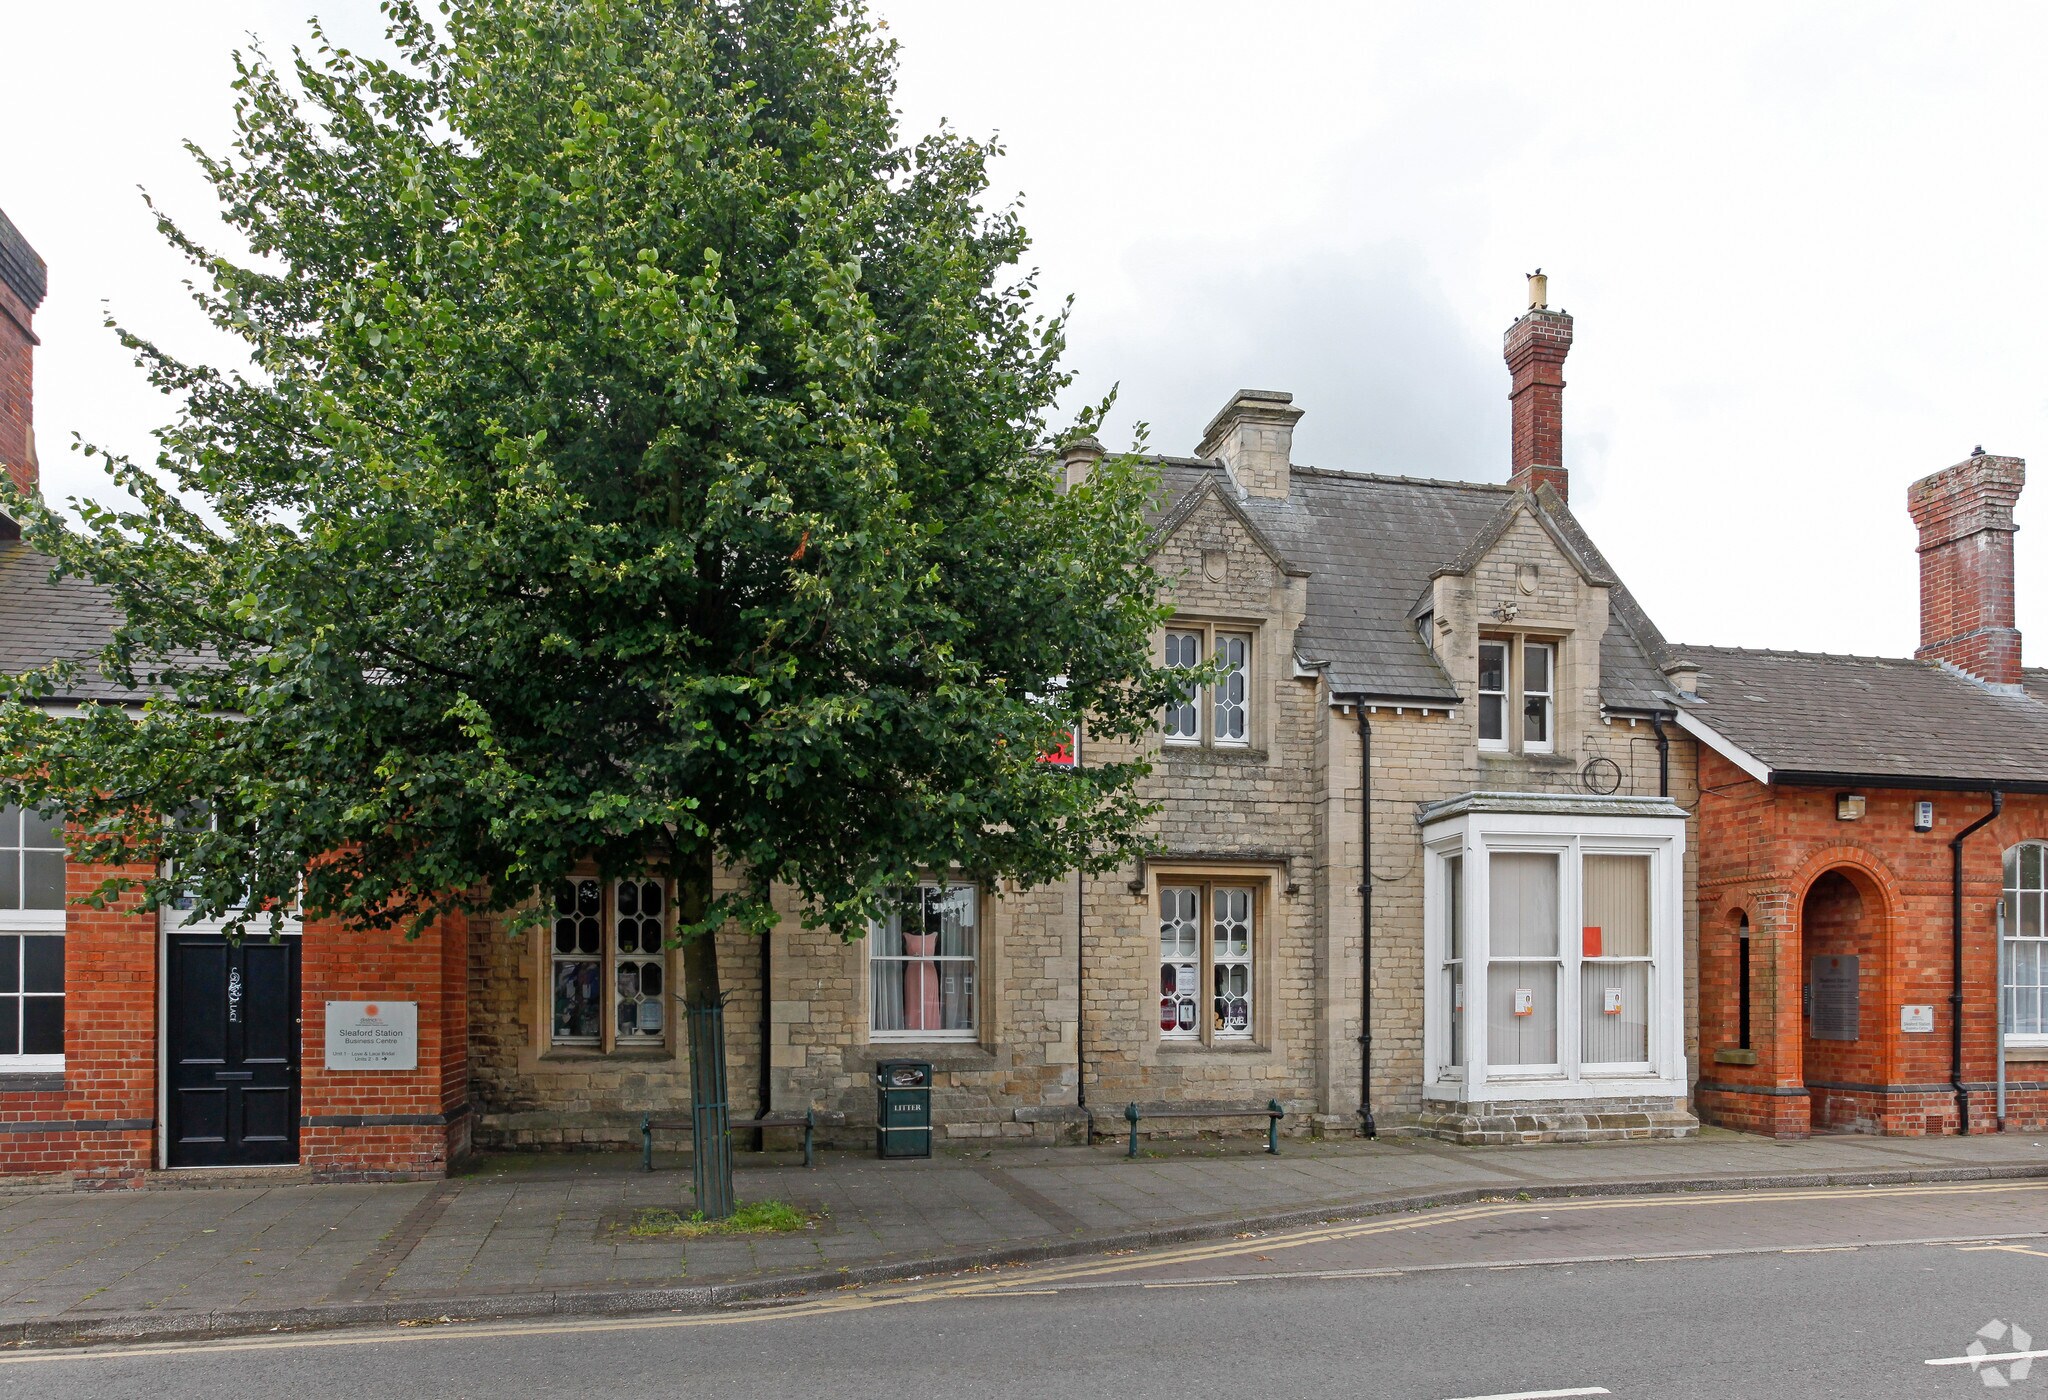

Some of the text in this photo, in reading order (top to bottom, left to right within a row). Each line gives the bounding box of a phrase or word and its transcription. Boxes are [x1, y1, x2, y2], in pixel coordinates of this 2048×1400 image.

[230, 1005, 238, 1022] LACE
[1224, 1016, 1245, 1025] LOVE
[339, 1029, 403, 1037] Sleaford Station
